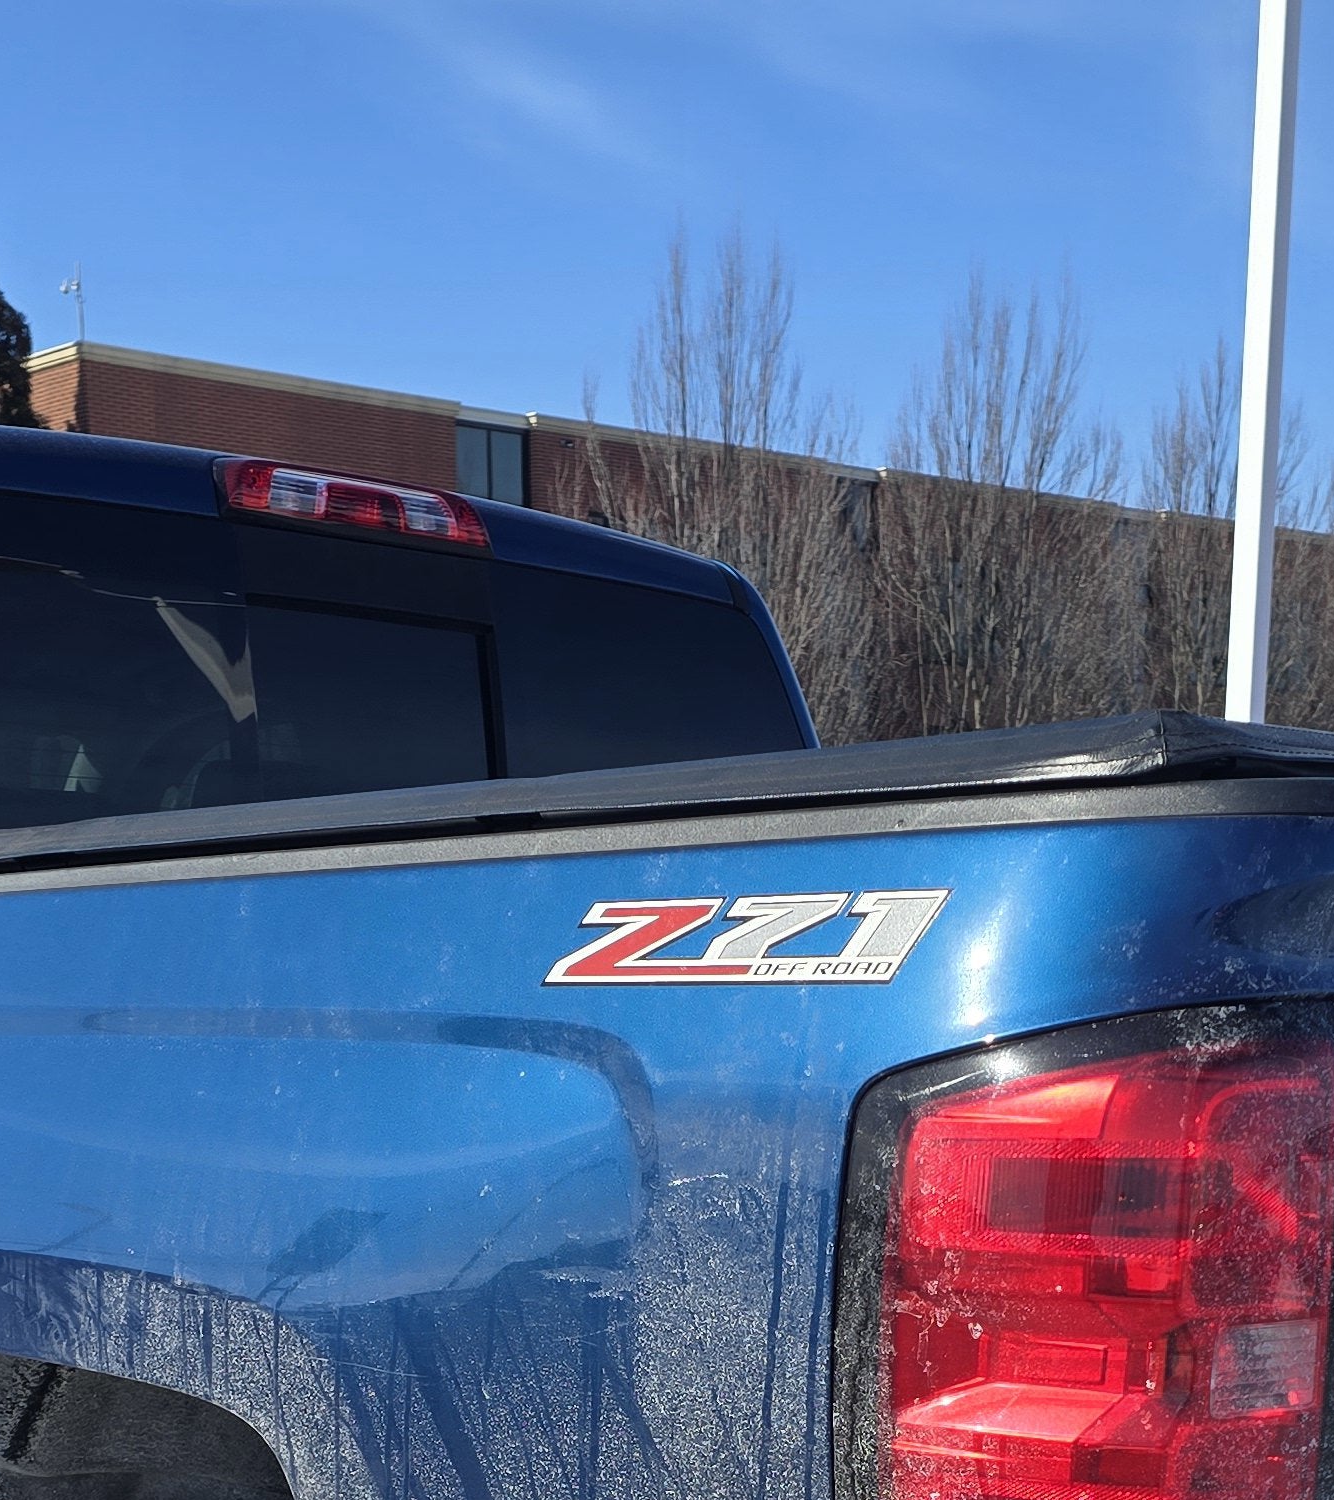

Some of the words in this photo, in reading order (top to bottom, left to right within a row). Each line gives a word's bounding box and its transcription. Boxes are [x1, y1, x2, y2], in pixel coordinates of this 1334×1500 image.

[541, 888, 954, 987] Z71
[753, 961, 807, 976] OFF
[811, 961, 893, 976] ROAD
